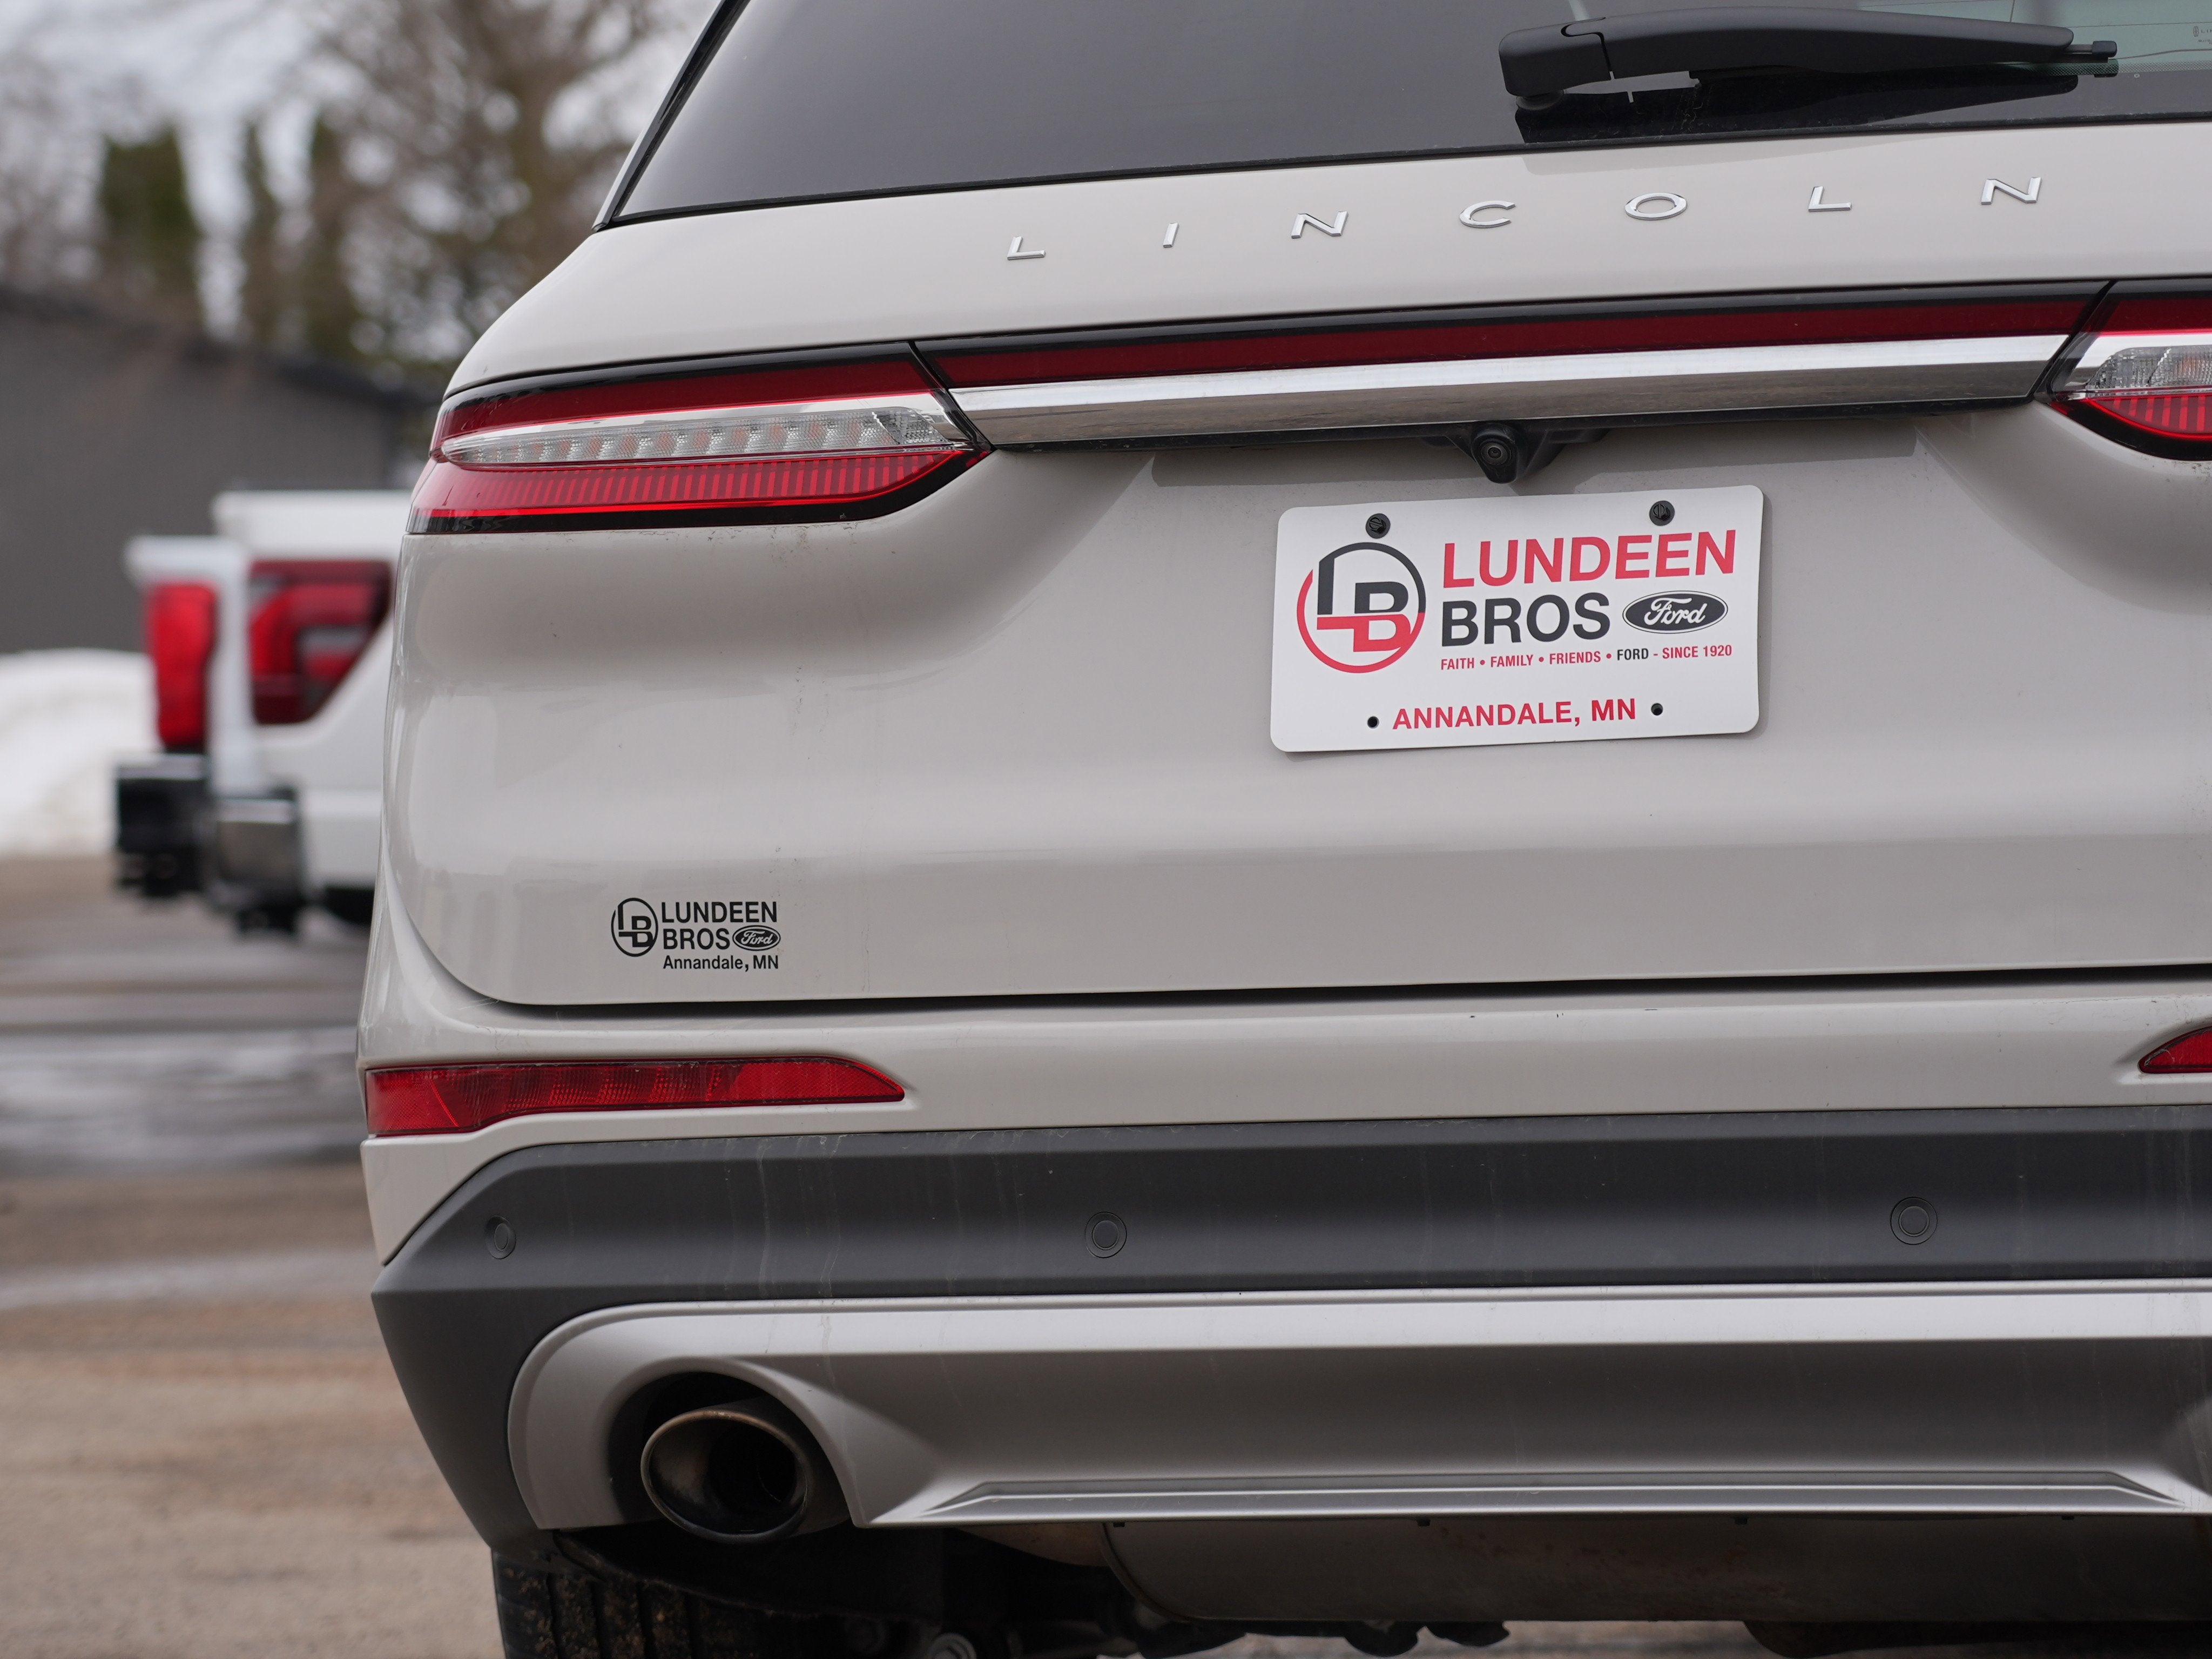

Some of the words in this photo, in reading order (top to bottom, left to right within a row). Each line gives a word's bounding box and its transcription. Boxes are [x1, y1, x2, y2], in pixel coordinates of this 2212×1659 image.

[1007, 177, 2042, 261] LINCOLN
[1443, 529, 1737, 589] LUNDEEN
[1441, 592, 1610, 647] BROS
[1644, 597, 1708, 626] Ford
[1441, 657, 1475, 670] FAITH
[1491, 655, 1534, 667] FAMILY
[1549, 651, 1602, 664] FRIENDS
[1617, 648, 1649, 660] FORD
[1662, 646, 1698, 659] SINCE
[1703, 644, 1732, 657] 1920
[1393, 700, 1581, 730] ANNANDALE,
[1591, 698, 1636, 721] MN
[661, 901, 777, 923] LUNDEEN
[663, 928, 730, 950] BROS
[740, 930, 773, 945] Ford
[663, 955, 750, 972] Annandale,
[753, 955, 779, 969] MN
